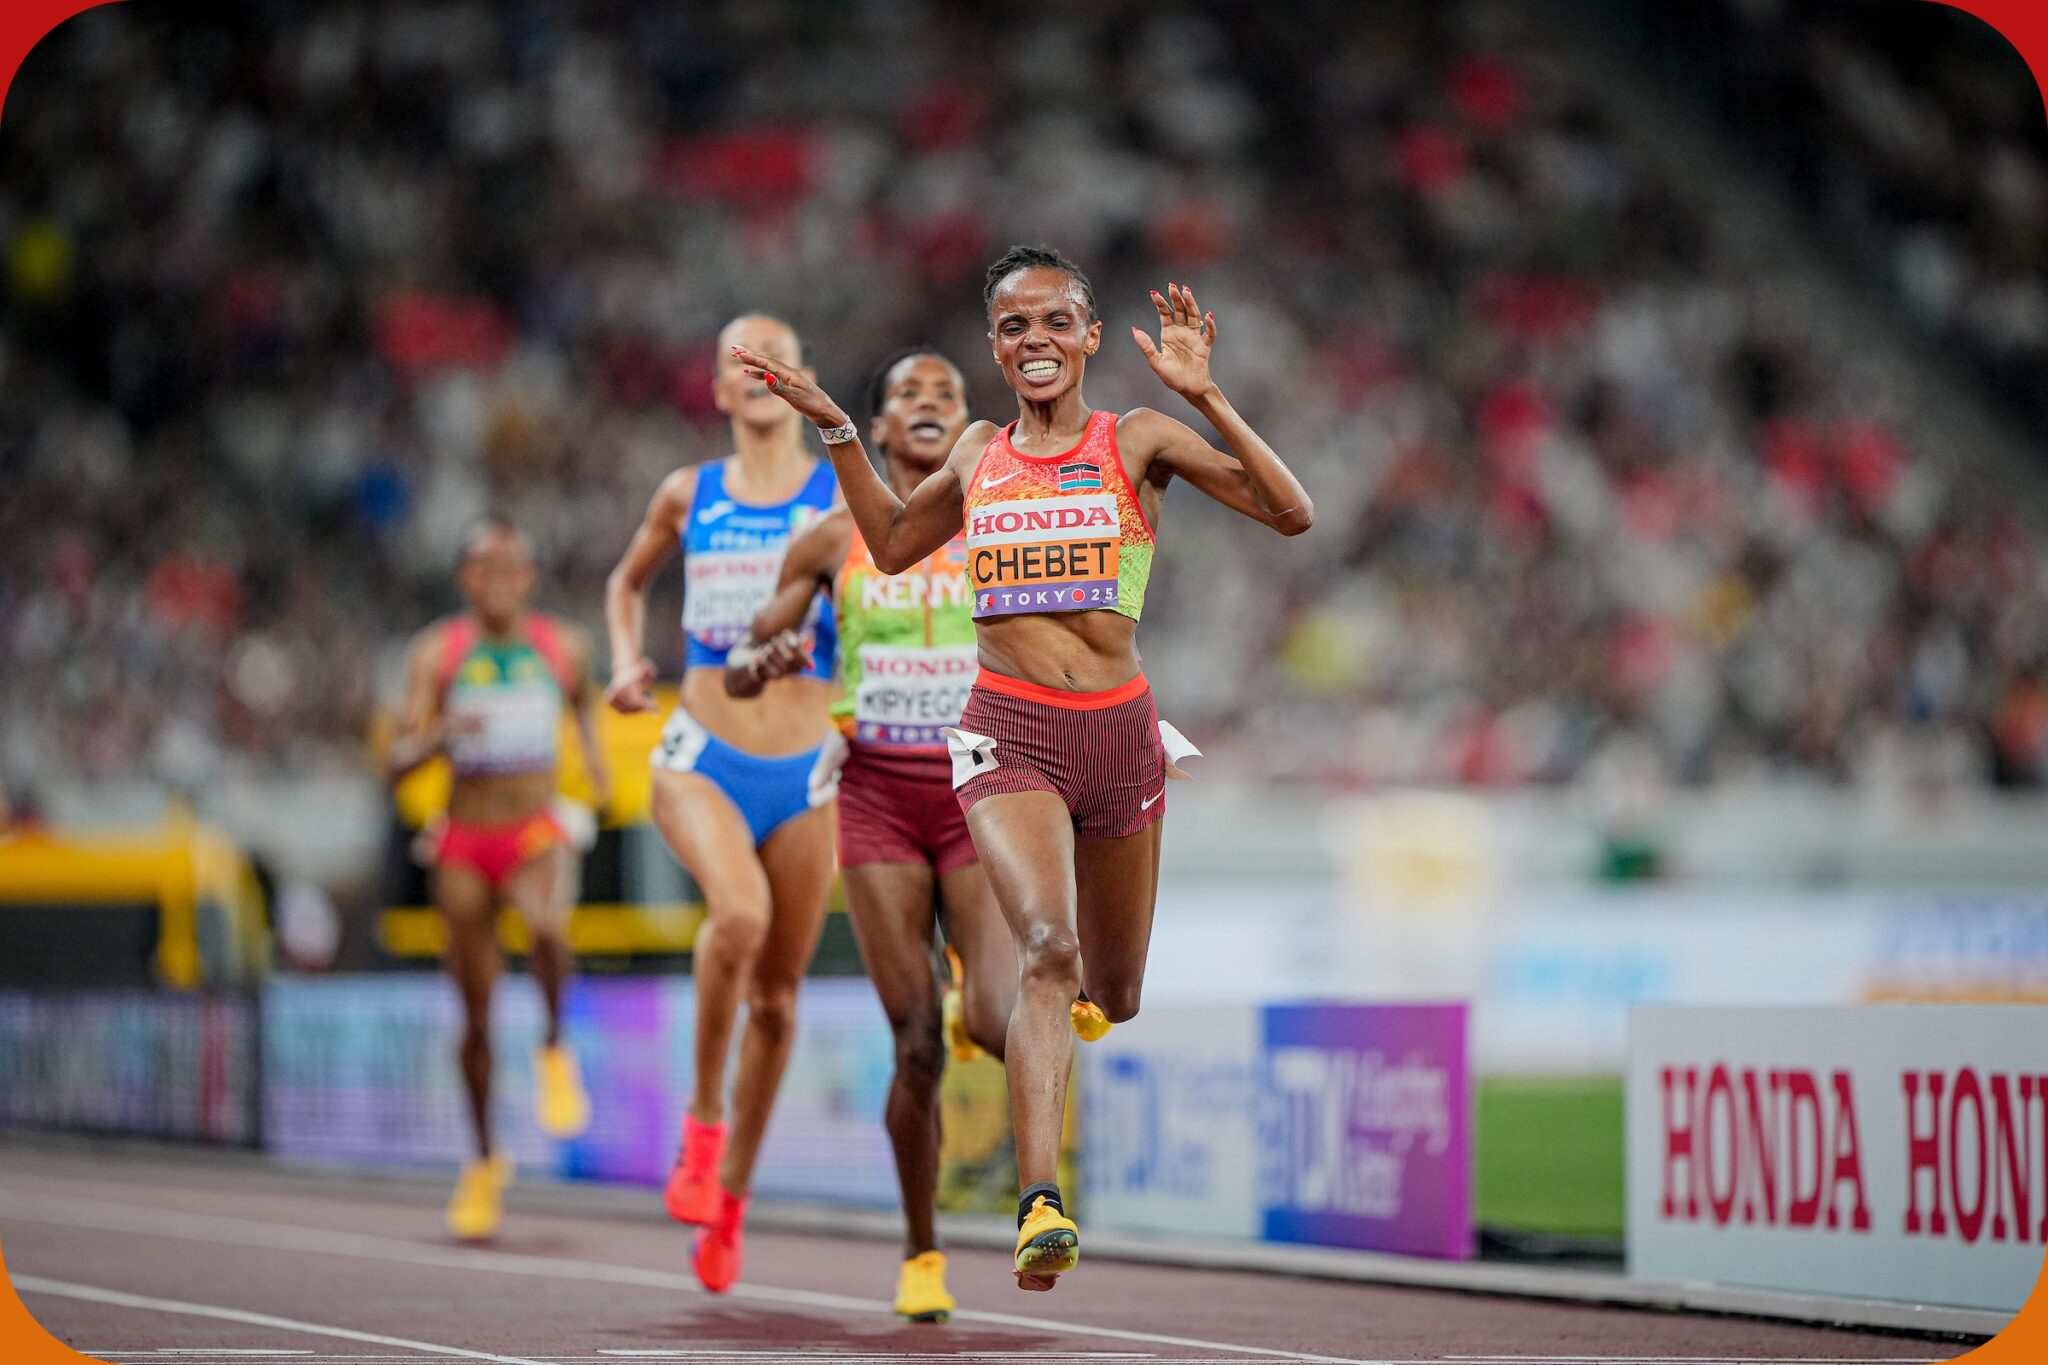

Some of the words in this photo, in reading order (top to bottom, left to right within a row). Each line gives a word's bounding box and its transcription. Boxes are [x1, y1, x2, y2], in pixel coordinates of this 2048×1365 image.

[971, 507, 1116, 537] HONDA
[975, 542, 1112, 584] CHEBET
[1659, 1062, 1872, 1231] HONDA
